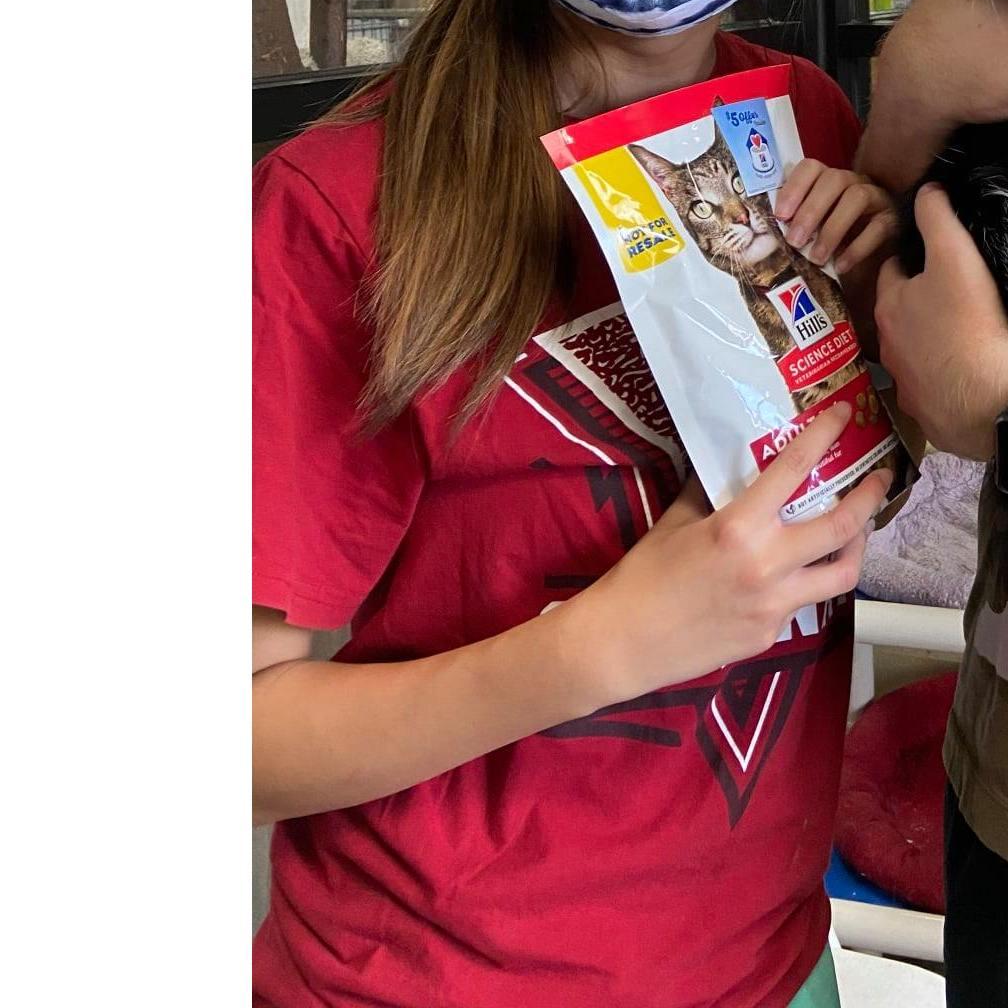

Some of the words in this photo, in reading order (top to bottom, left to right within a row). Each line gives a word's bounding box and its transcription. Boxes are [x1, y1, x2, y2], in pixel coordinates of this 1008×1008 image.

[648, 217, 669, 232] FOR
[627, 227, 676, 258] RESALE
[796, 313, 828, 341] Hill's
[788, 341, 836, 377] SCIENCE
[833, 327, 854, 349] DIET
